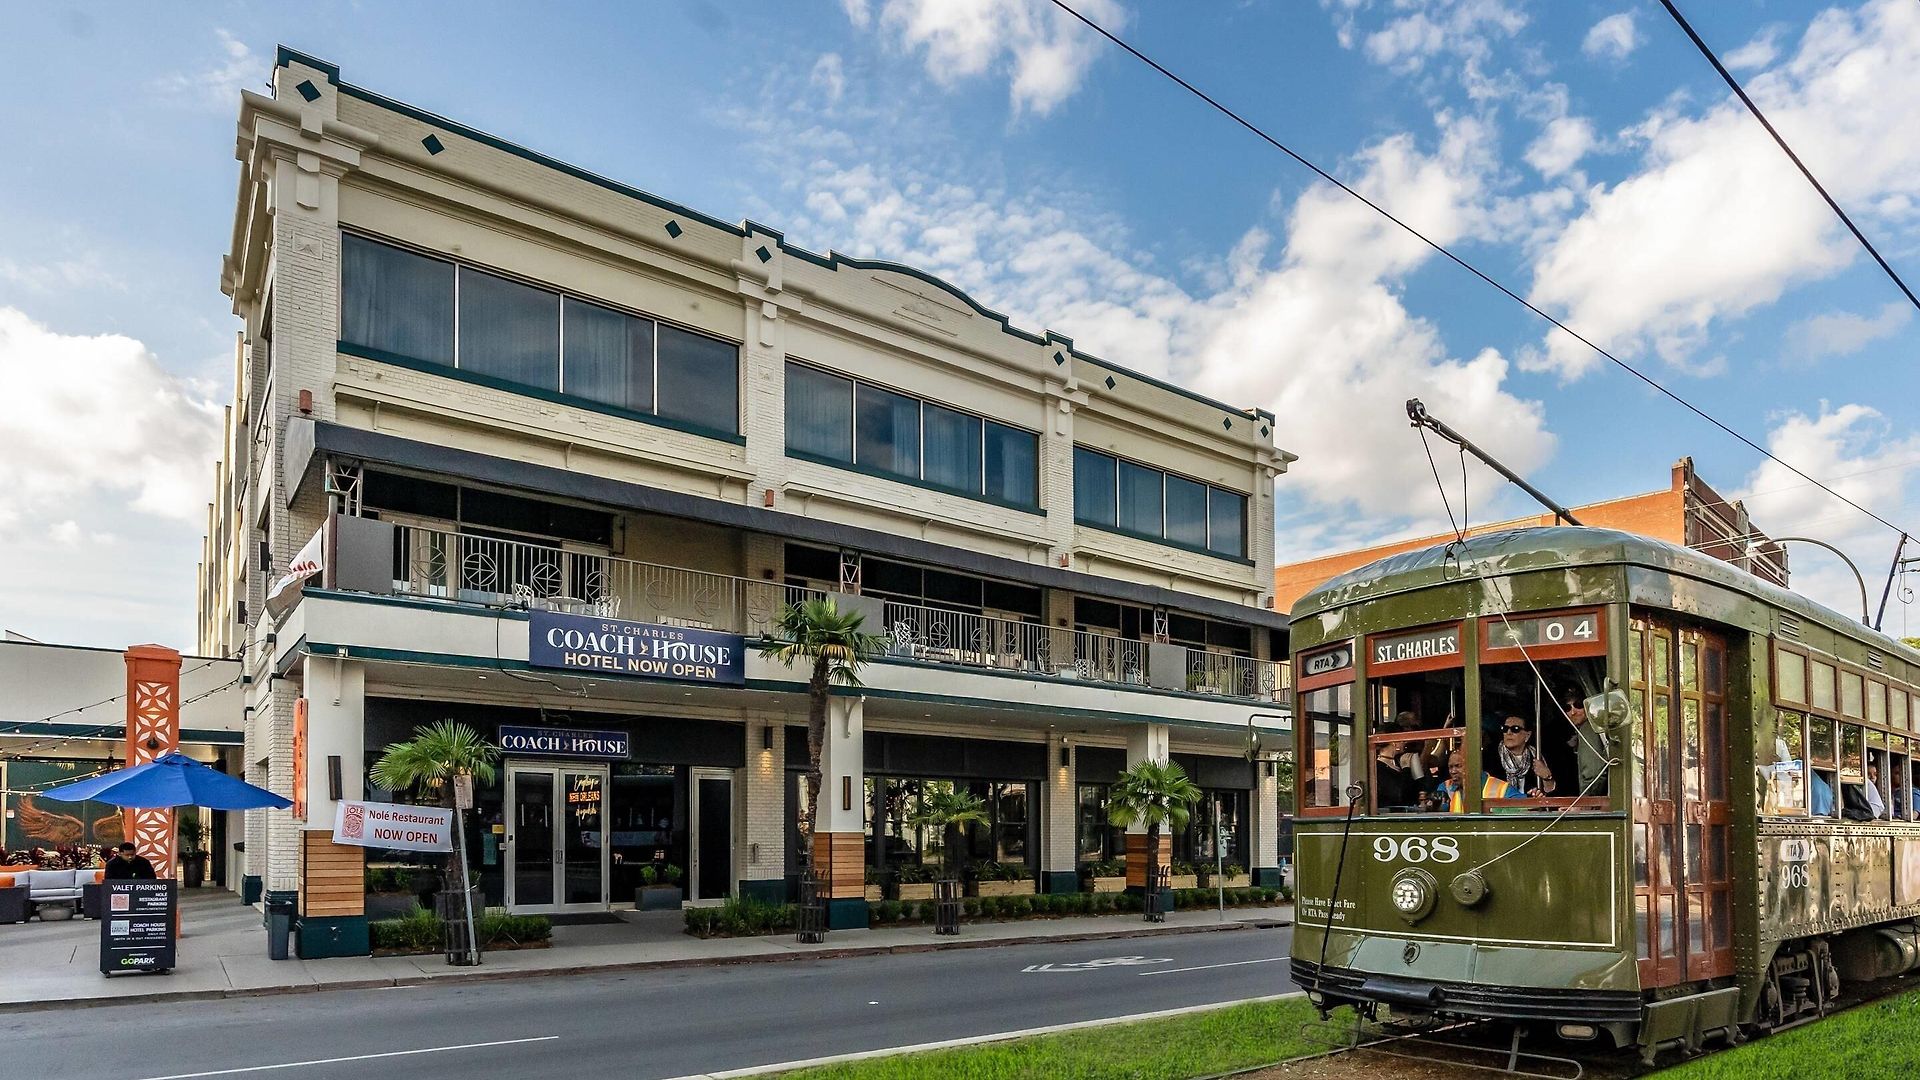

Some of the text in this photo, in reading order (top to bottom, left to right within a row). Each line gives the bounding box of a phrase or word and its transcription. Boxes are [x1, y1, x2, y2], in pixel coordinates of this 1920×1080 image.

[602, 623, 684, 641] ST. CHARLES
[547, 627, 731, 666] COACH HOUSE
[1377, 636, 1455, 662] ST. CHARLES
[564, 652, 716, 679] HOTEL NOW OPEN
[1314, 657, 1330, 670] RTA
[501, 735, 626, 754] COACH HOUSE
[369, 810, 445, 825] Nolé Restaurant
[374, 828, 438, 844] NOW OPEN
[1373, 836, 1460, 863] 968
[1782, 863, 1809, 889] 968
[1314, 897, 1326, 907] Have
[1327, 898, 1342, 908] Eact
[1343, 899, 1356, 909] Fare
[1331, 911, 1346, 922] eady
[121, 957, 155, 965] GOPARK
